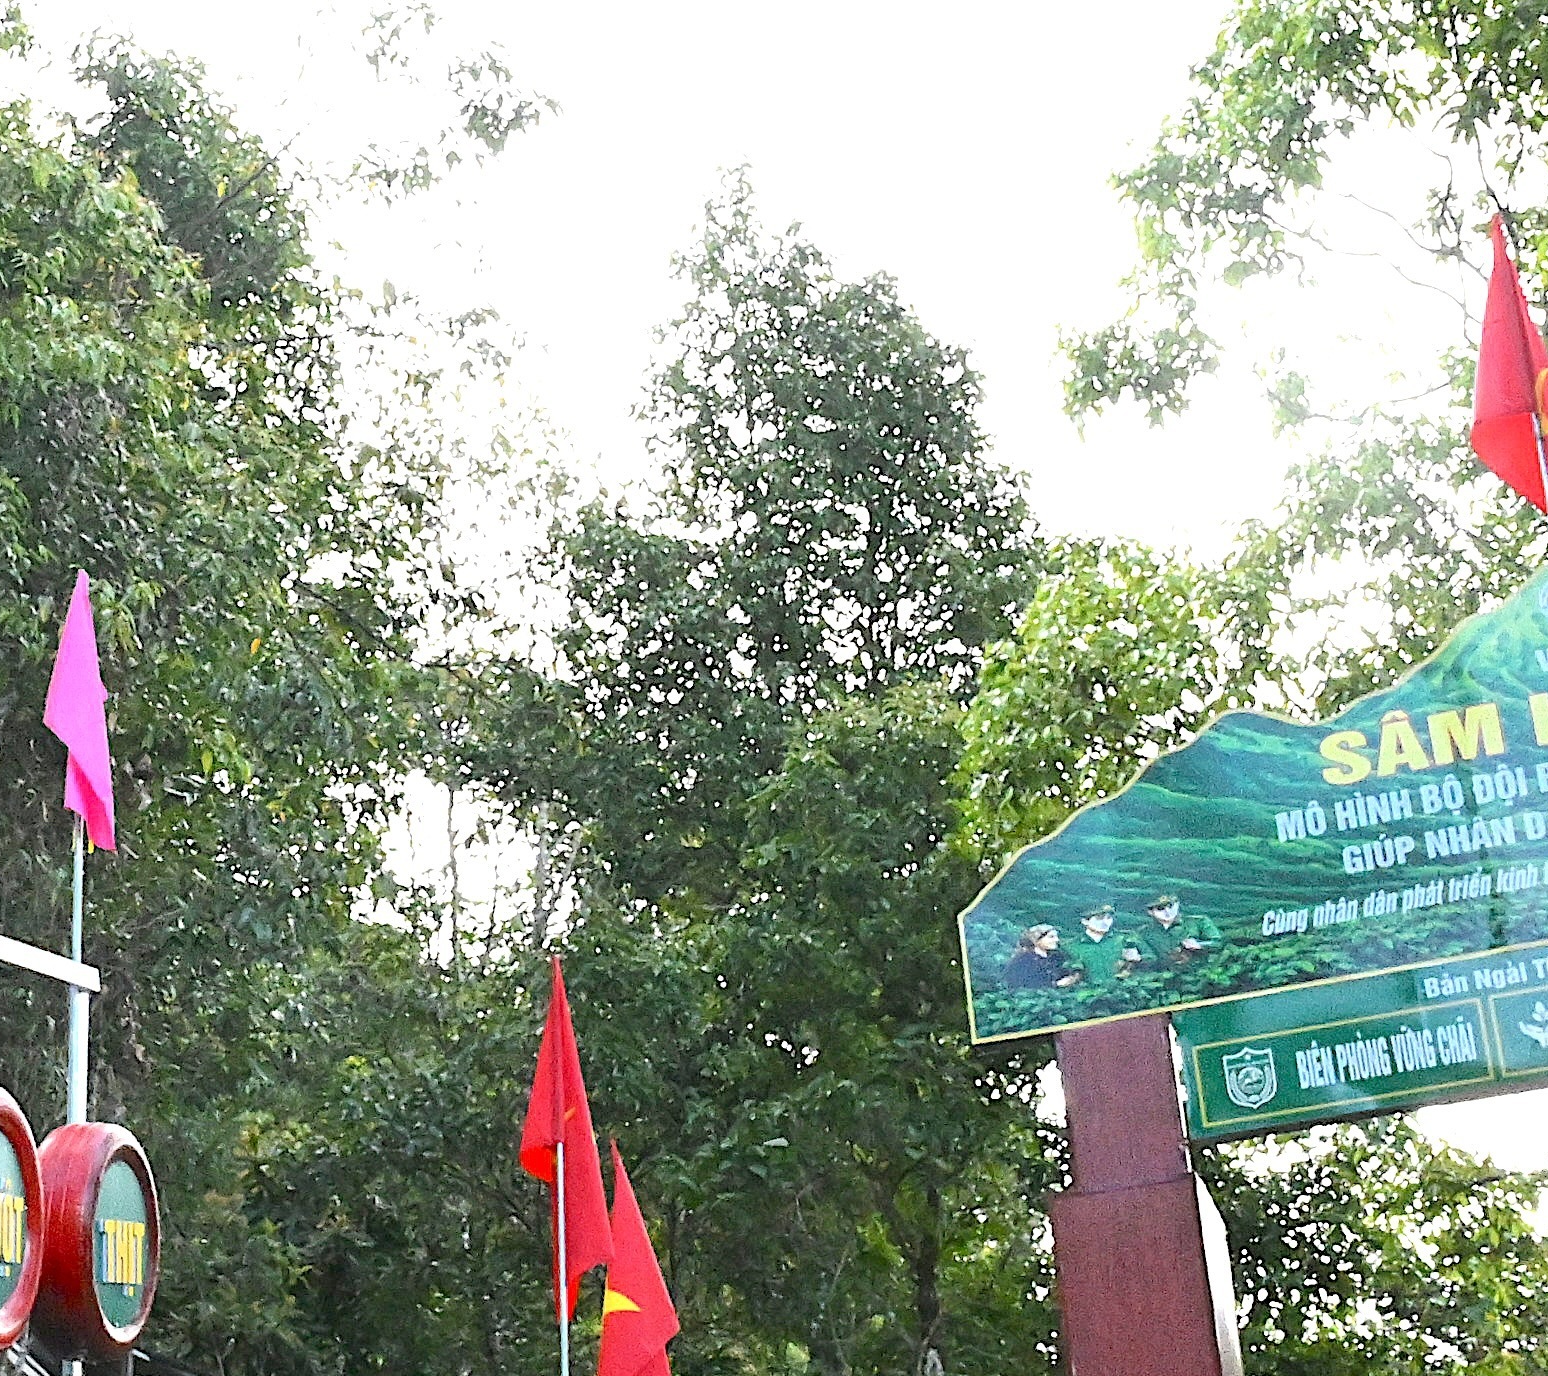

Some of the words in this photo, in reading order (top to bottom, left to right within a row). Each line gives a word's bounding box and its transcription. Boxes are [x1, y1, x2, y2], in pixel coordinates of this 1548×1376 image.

[1319, 702, 1506, 786] SÂM
[1275, 800, 1327, 843] MÔ
[1334, 789, 1413, 832] HÌNH
[1419, 774, 1465, 816] BỘ
[1472, 764, 1529, 807] ĐỘI
[1342, 833, 1416, 875] GIÚP
[1424, 812, 1516, 859] NHÂN
[1261, 906, 1309, 936] Cùng
[1312, 895, 1358, 927] nhân
[1363, 886, 1398, 917] dân
[1401, 879, 1445, 914] phát
[1447, 867, 1492, 902] triển
[1495, 863, 1540, 895] kinh
[1423, 971, 1470, 999] Bản
[1294, 1040, 1337, 1090] BIÊN
[1334, 1031, 1393, 1084] PHÒNG
[98, 1219, 146, 1297] THỊT
